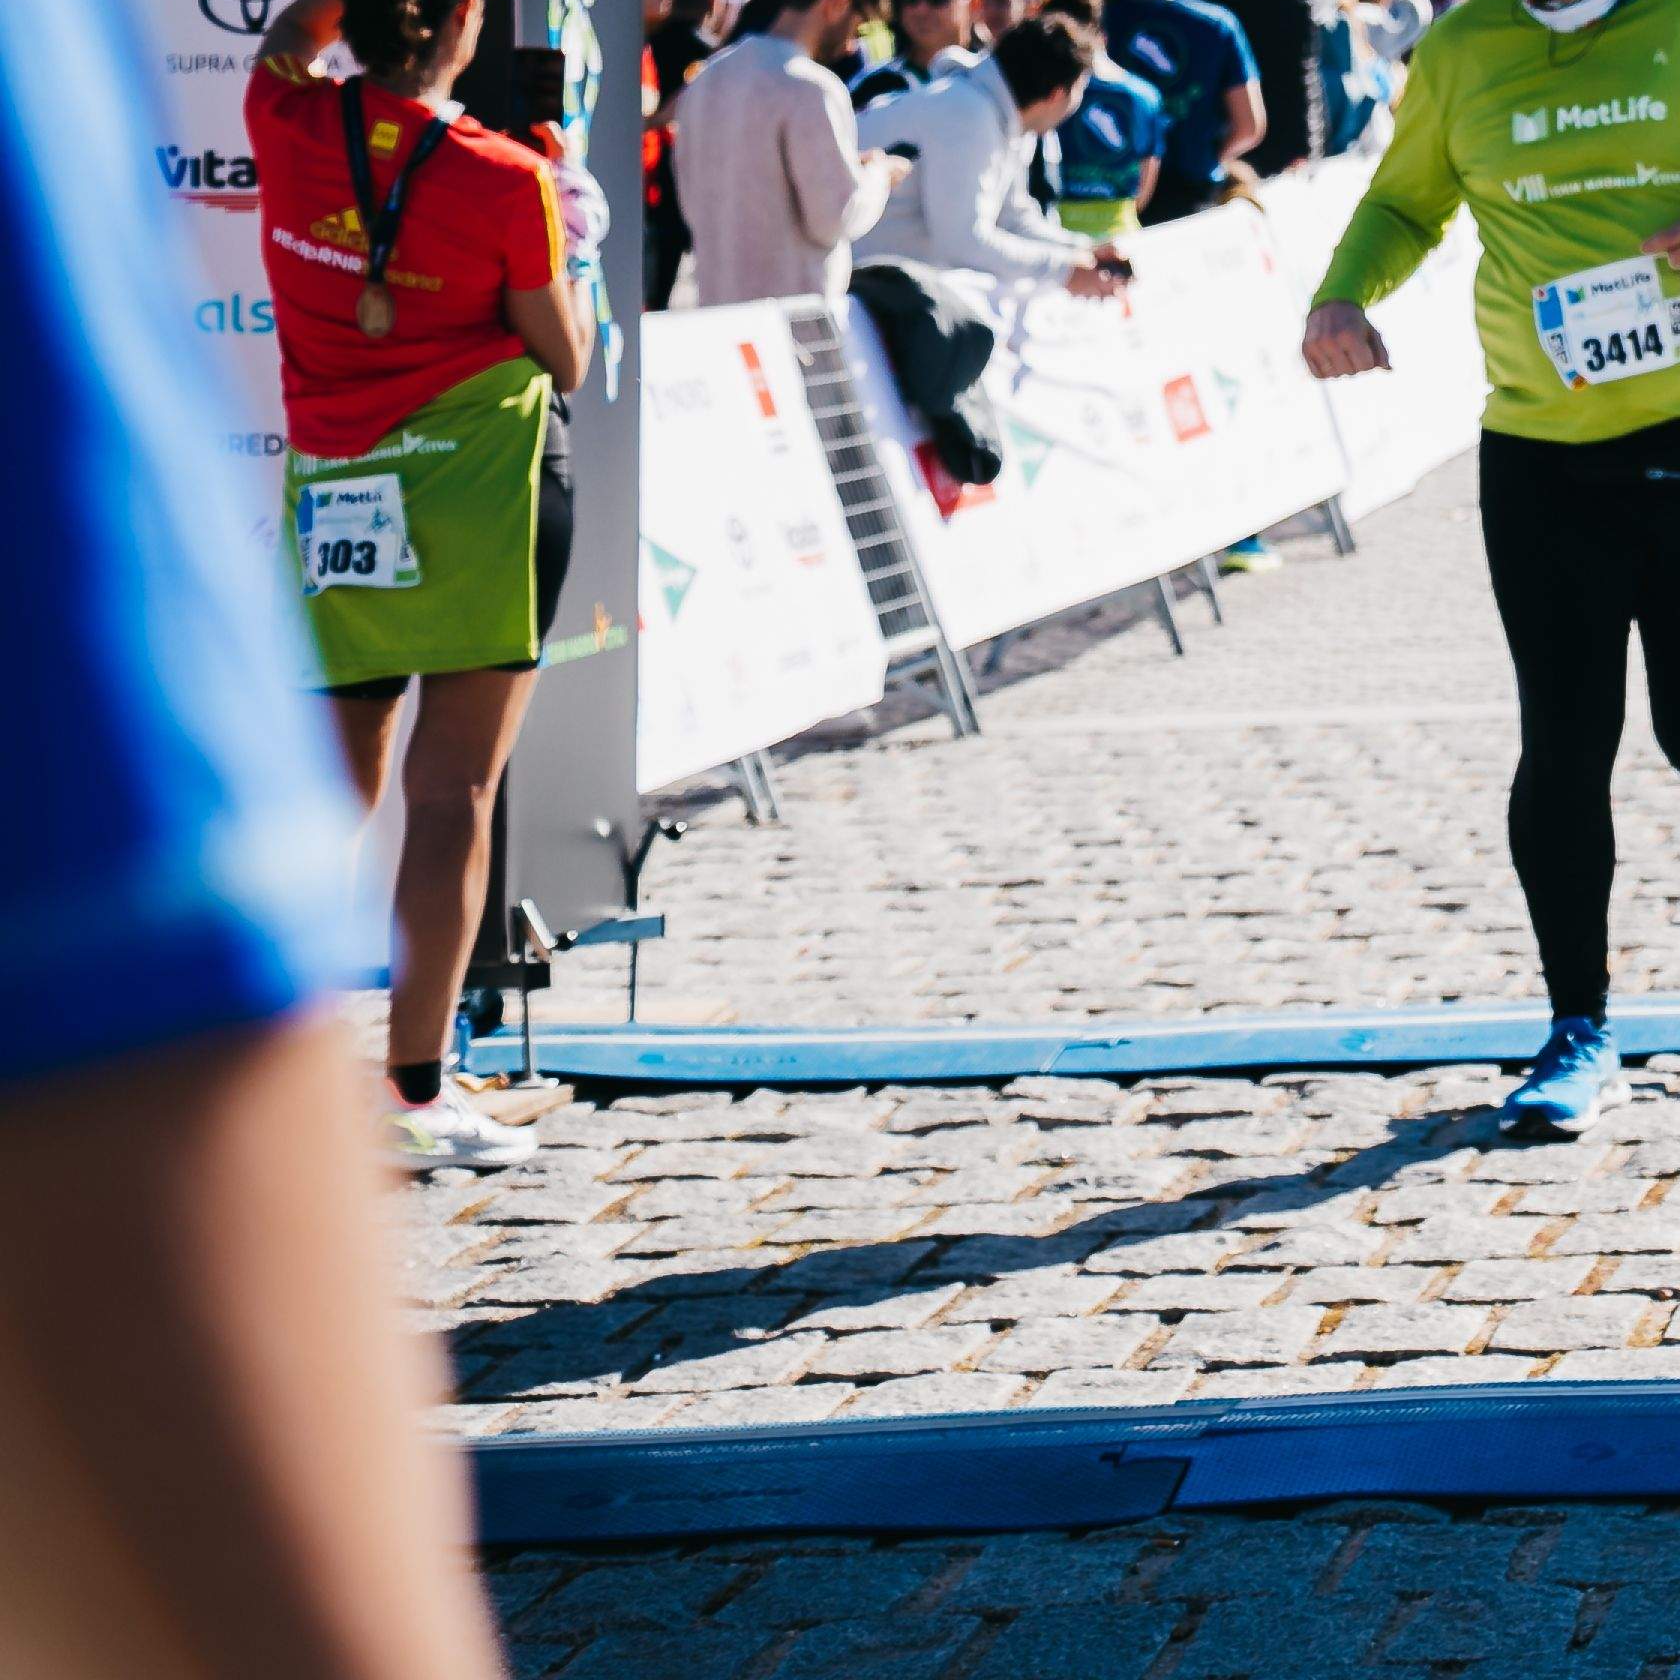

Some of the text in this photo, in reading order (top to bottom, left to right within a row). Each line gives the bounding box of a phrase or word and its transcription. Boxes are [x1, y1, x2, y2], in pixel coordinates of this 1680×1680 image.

[165, 52, 236, 74] SUPRA
[1555, 95, 1668, 132] MetLife
[156, 144, 257, 189] Vita
[194, 293, 275, 334] als
[1582, 324, 1664, 372] 3414
